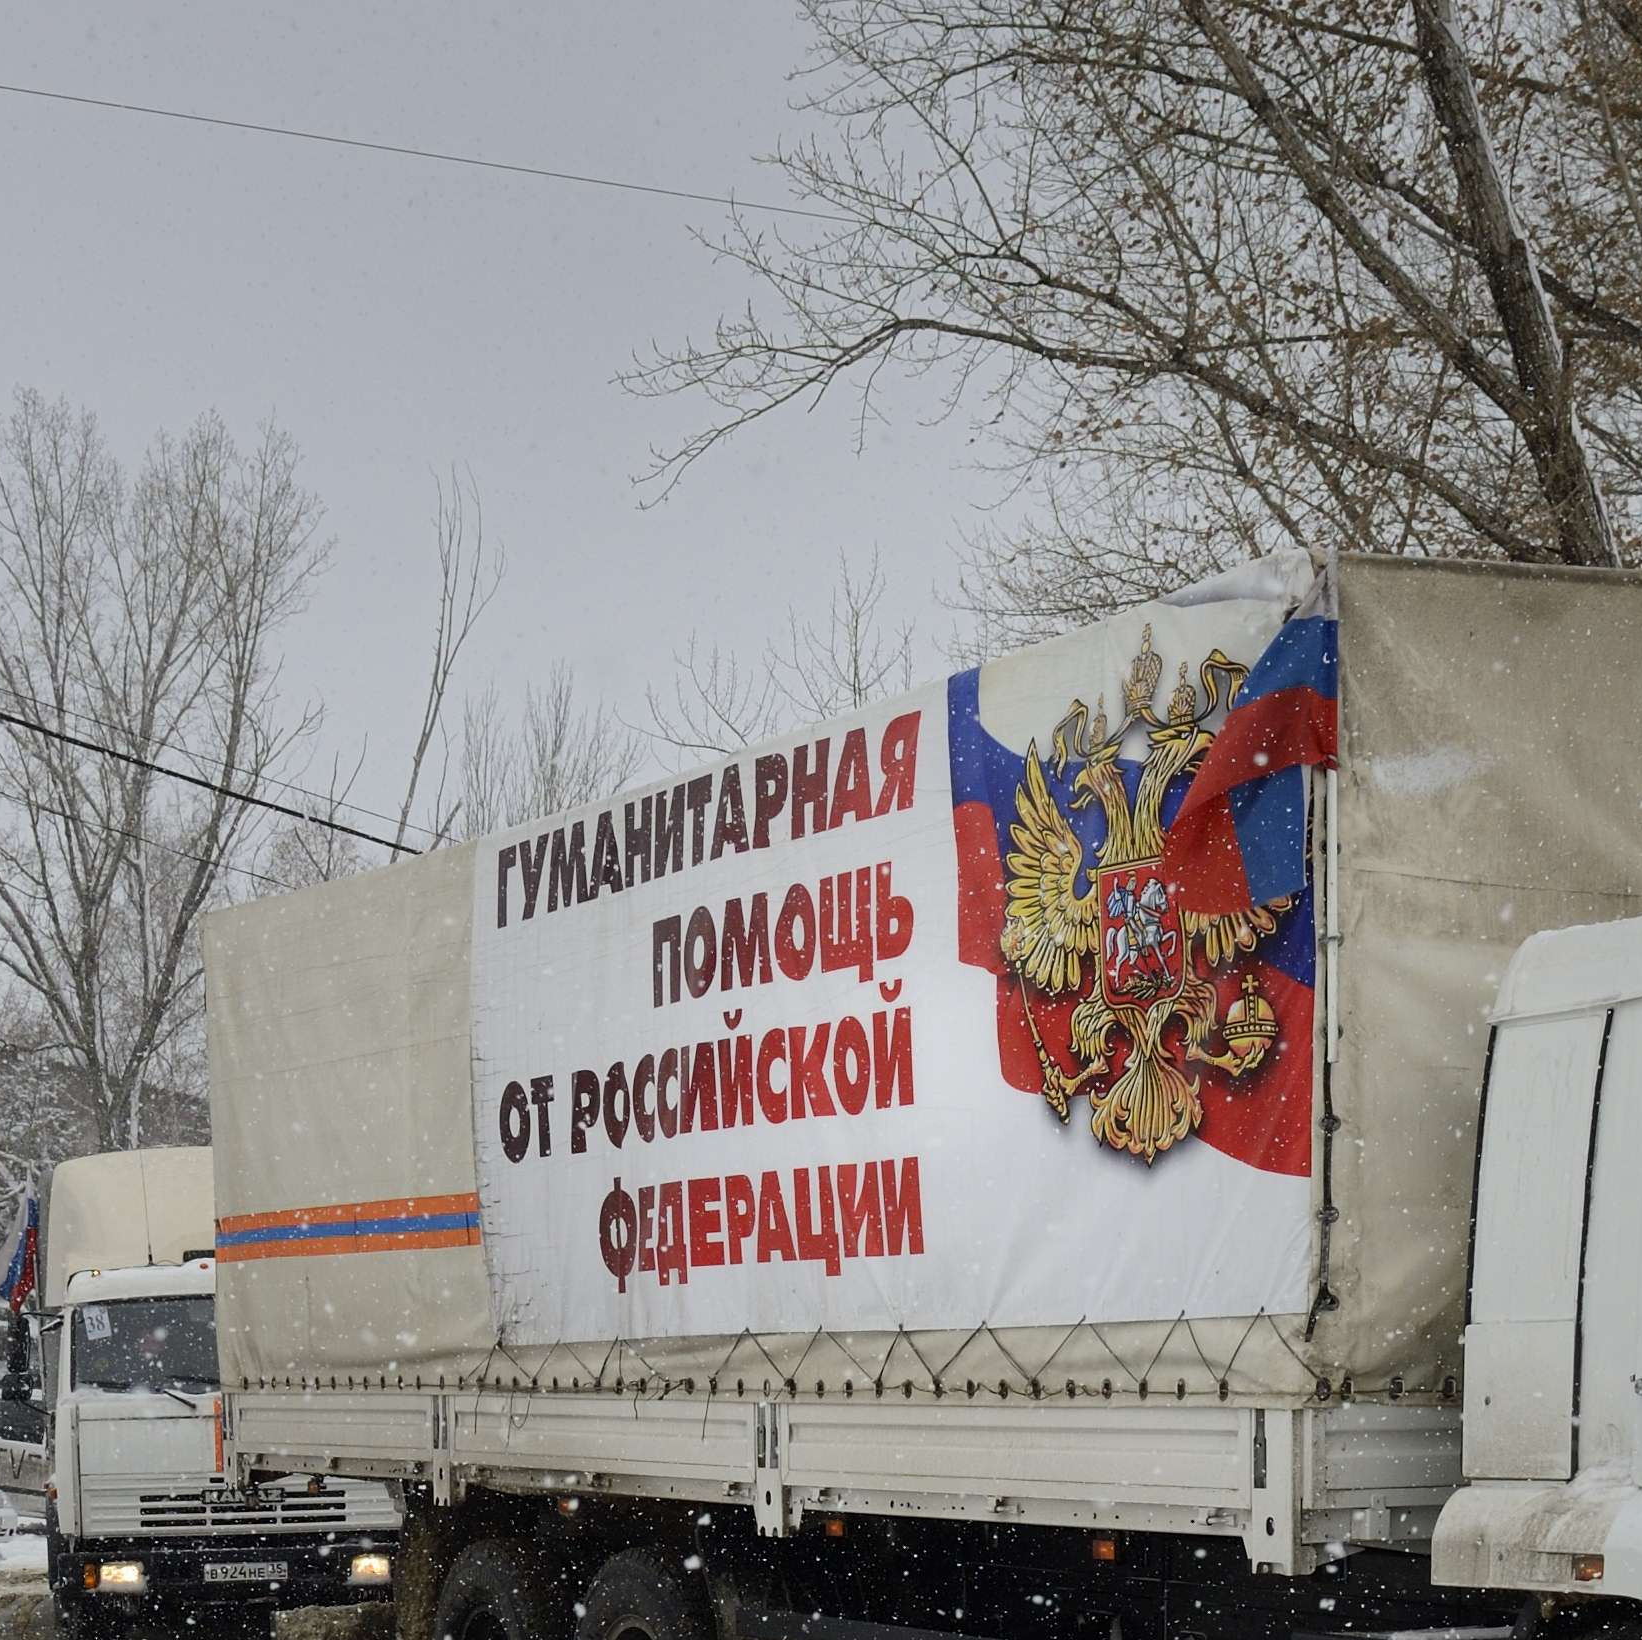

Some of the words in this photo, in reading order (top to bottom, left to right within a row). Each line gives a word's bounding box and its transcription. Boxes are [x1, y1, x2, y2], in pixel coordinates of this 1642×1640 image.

[497, 711, 922, 929] ГУМАНИТАРНАЯ
[653, 861, 915, 1008] ПОМОЩЬ
[500, 1075, 555, 1164] ОТ
[571, 978, 916, 1154] РОССИЙСКОЙ
[599, 1157, 925, 1293] ФЕДЕРАЦИИ
[86, 1314, 106, 1333] 38
